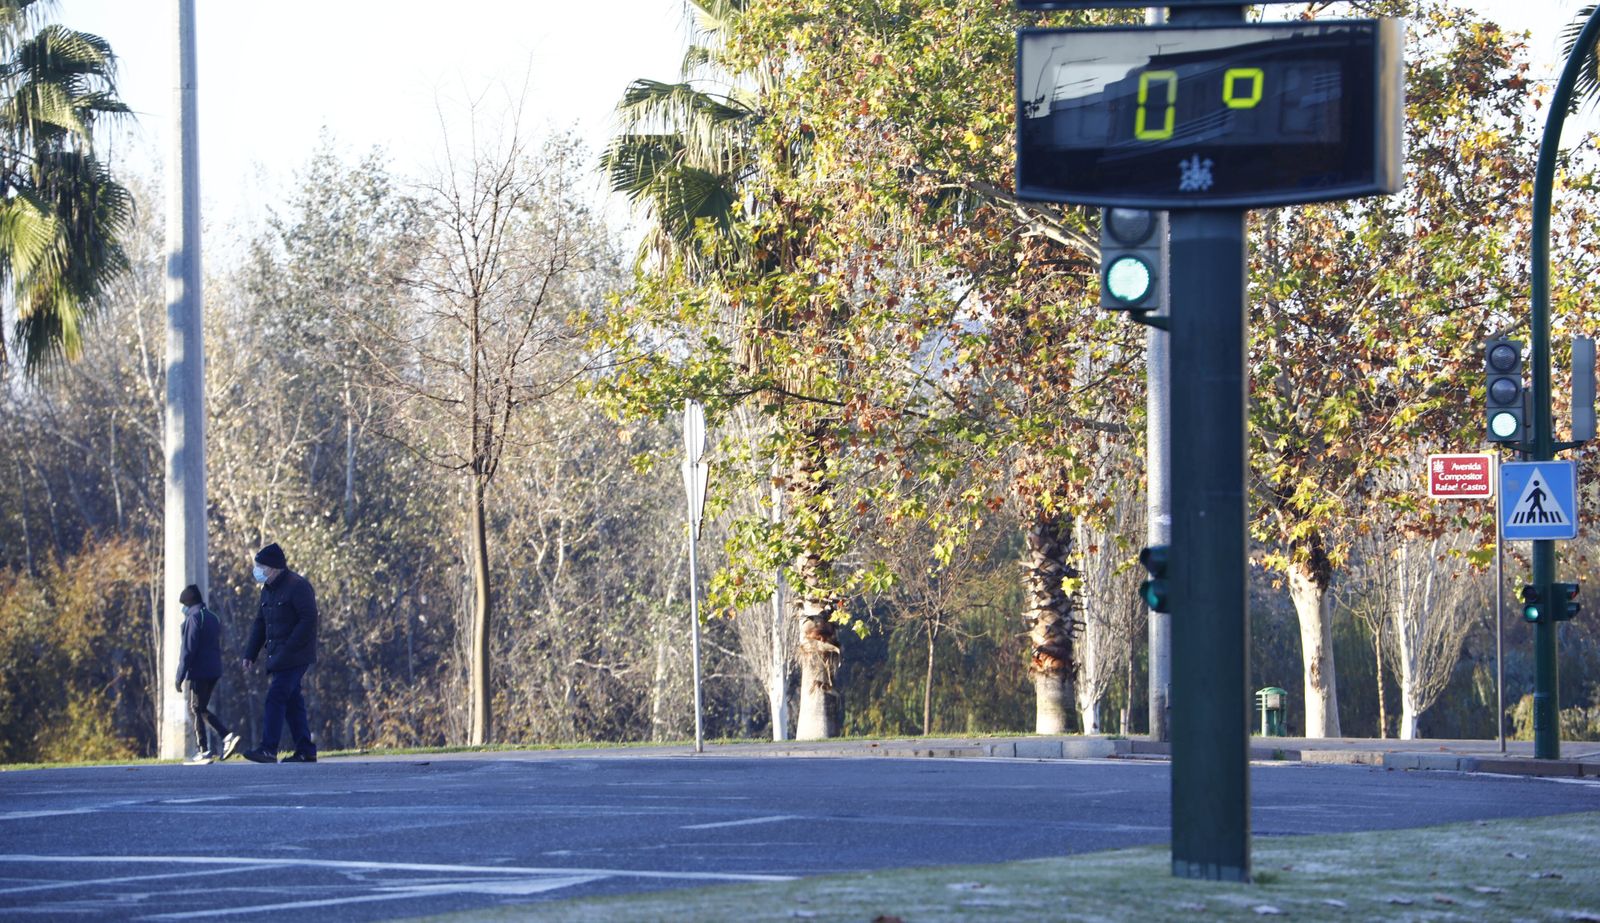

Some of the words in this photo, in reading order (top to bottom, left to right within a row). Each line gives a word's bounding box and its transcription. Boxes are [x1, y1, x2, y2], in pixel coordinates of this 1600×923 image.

[1451, 462, 1481, 470] Avenida
[1438, 473, 1483, 481] Compositor
[1435, 483, 1458, 491] Rafael
[1461, 483, 1487, 491] Castro
